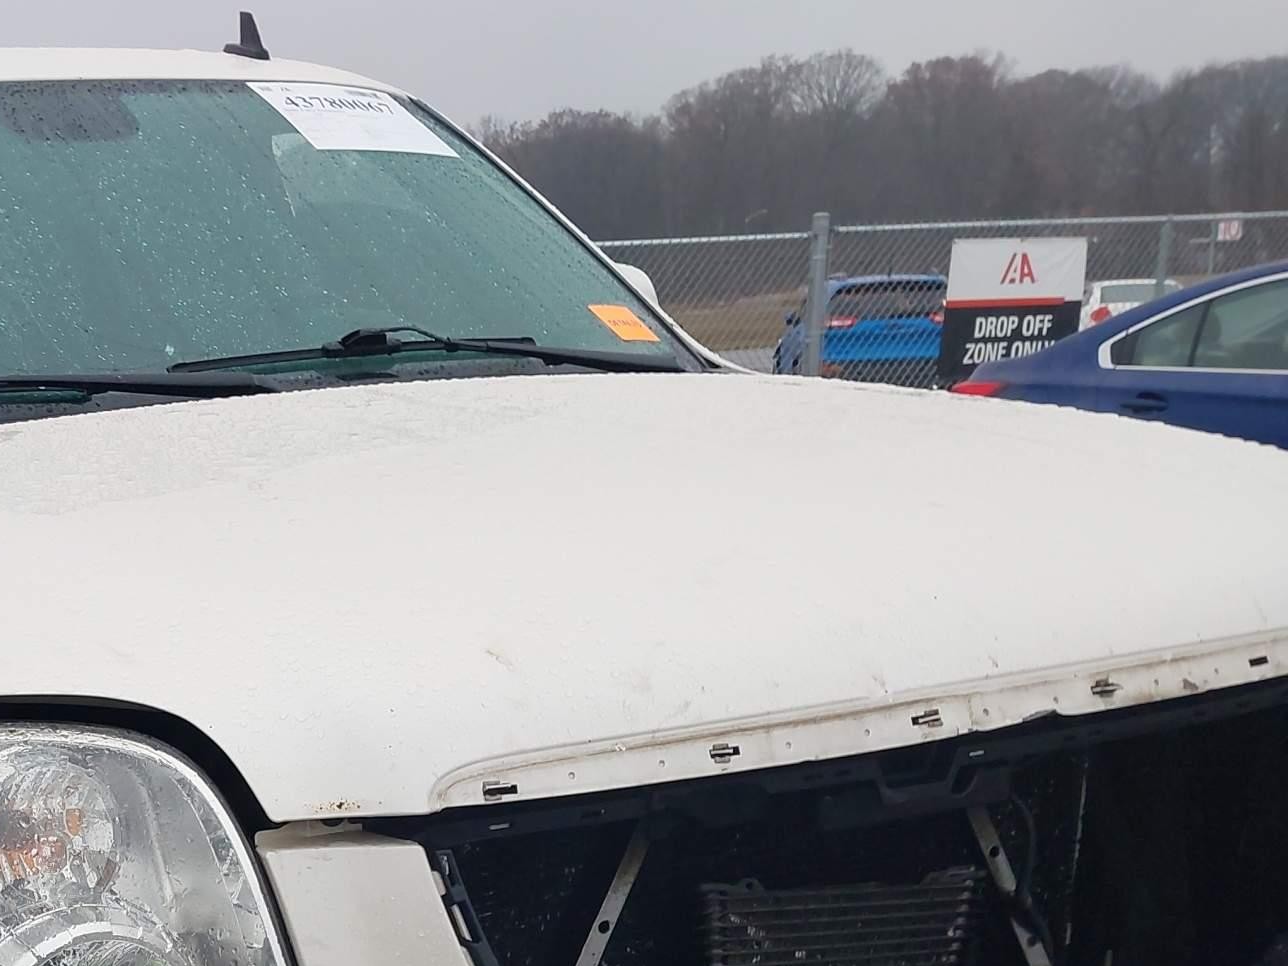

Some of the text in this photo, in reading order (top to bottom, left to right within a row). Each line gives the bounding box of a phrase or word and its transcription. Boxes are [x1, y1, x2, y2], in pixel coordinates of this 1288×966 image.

[284, 95, 395, 116] 43780067
[973, 314, 1053, 339] DROP OFF
[962, 341, 1008, 365] ZONE
